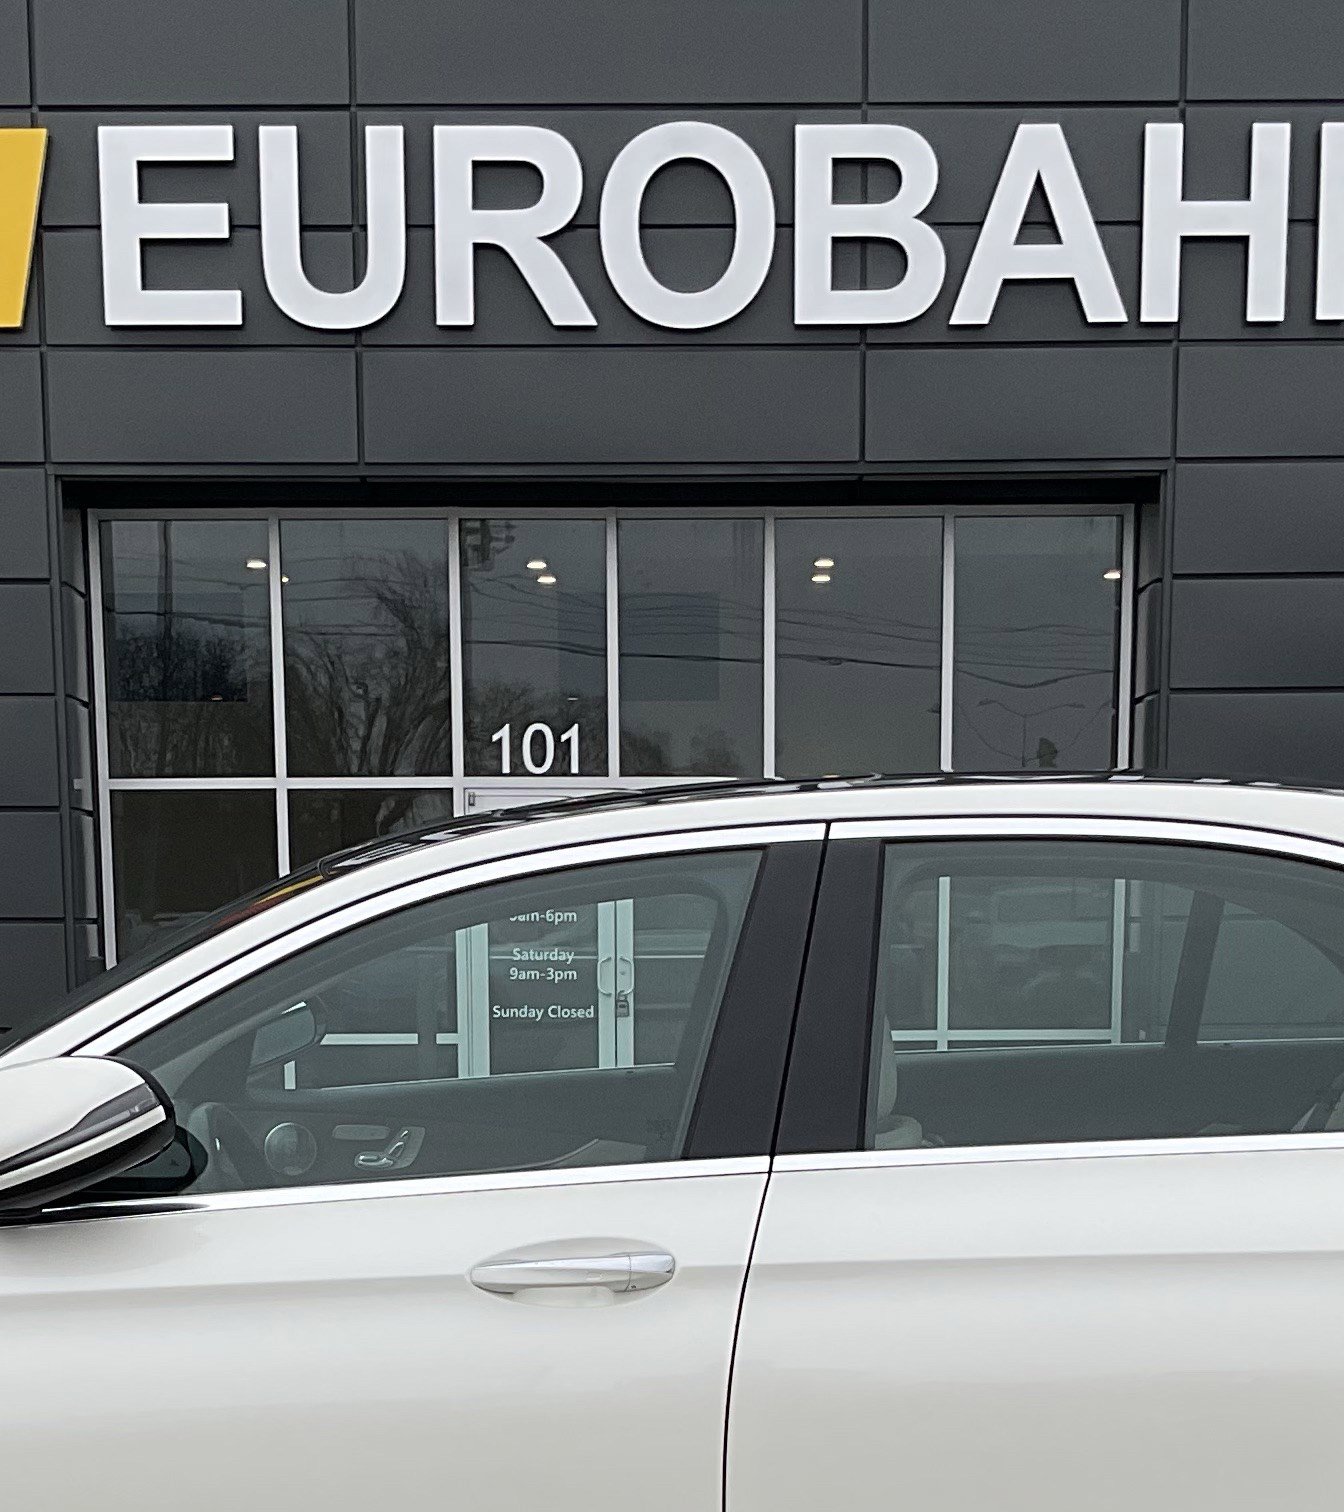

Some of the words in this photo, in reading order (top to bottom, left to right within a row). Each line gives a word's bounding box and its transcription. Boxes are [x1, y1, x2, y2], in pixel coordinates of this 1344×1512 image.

[491, 722, 580, 775] 101
[512, 947, 575, 965] Saturday
[509, 966, 578, 984] 9am-3pm
[492, 1004, 544, 1022] Sunday
[547, 1004, 595, 1019] Closed
